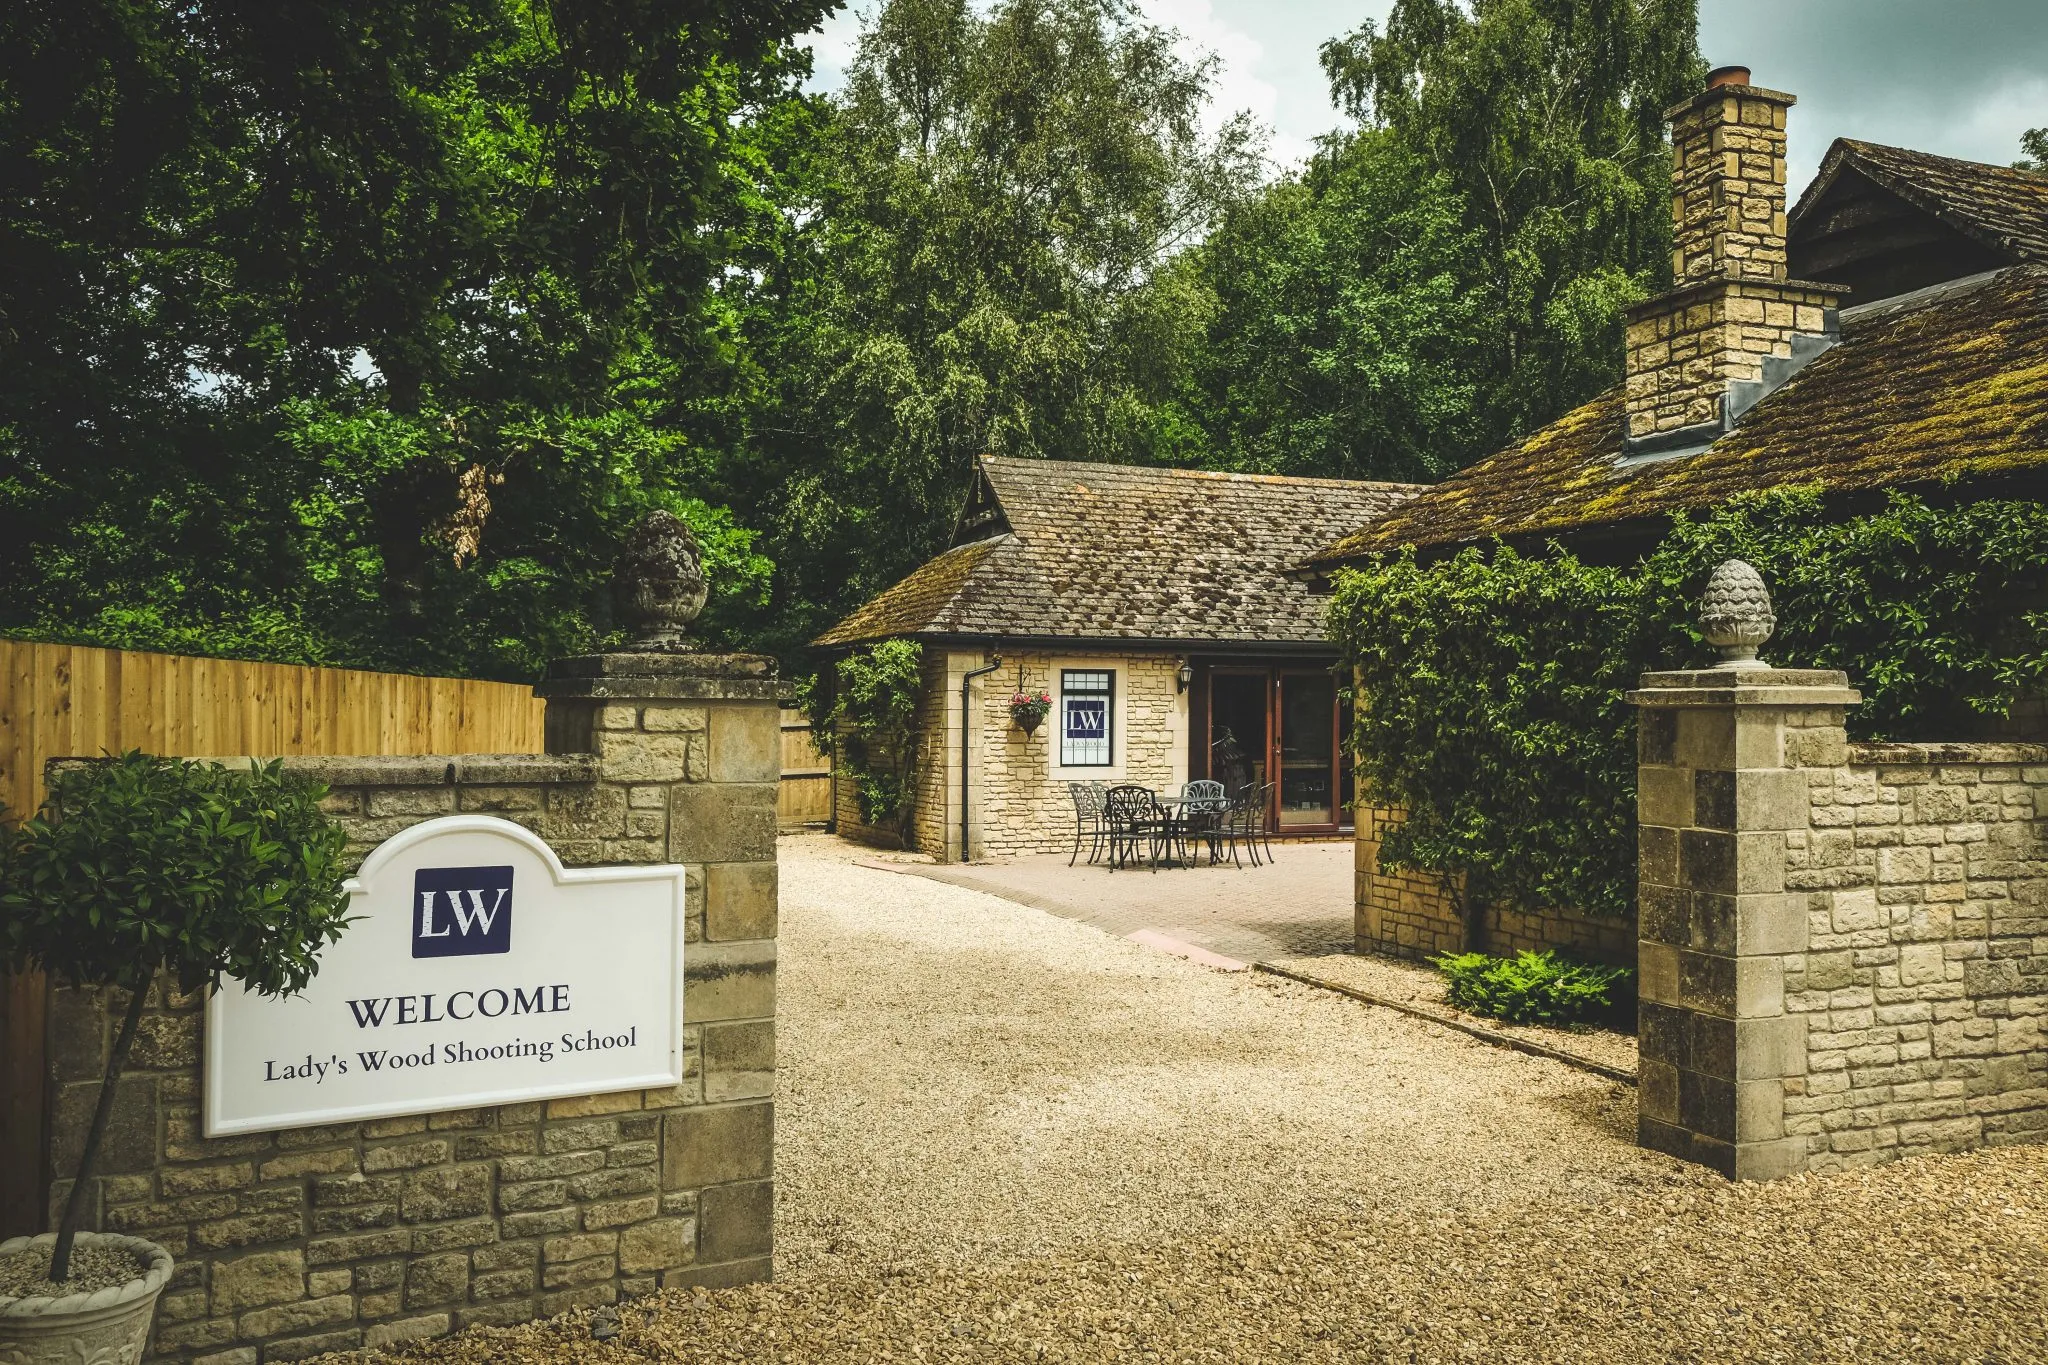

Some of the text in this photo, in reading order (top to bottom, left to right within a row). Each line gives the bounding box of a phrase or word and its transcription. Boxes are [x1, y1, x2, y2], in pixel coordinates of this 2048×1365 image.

[1069, 710, 1103, 730] LW
[418, 888, 509, 938] LW
[346, 984, 571, 1029] WELCOME
[264, 1026, 636, 1085] Lady's Wood Shooting School
